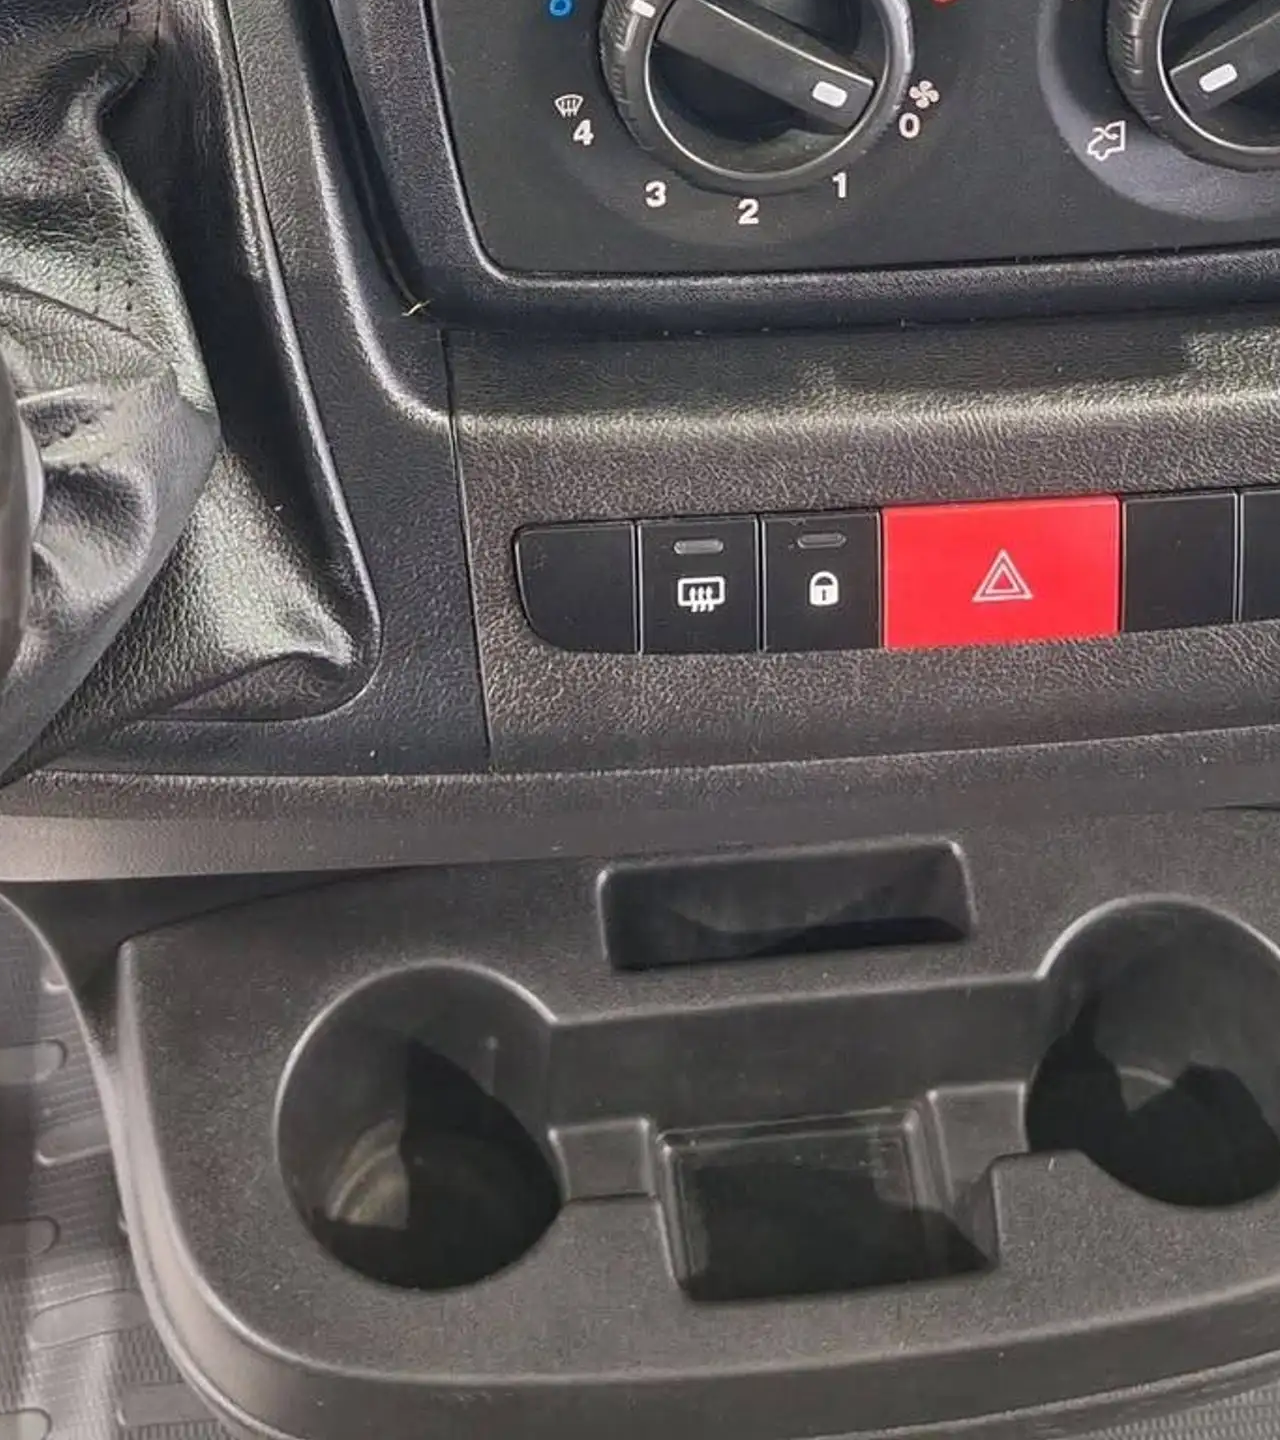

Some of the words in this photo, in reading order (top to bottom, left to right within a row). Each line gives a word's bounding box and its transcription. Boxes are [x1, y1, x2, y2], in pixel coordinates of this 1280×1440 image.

[573, 119, 594, 146] 4
[899, 112, 920, 139] 0
[645, 180, 666, 208] 3
[832, 171, 847, 199] 1
[738, 198, 759, 225] 2
